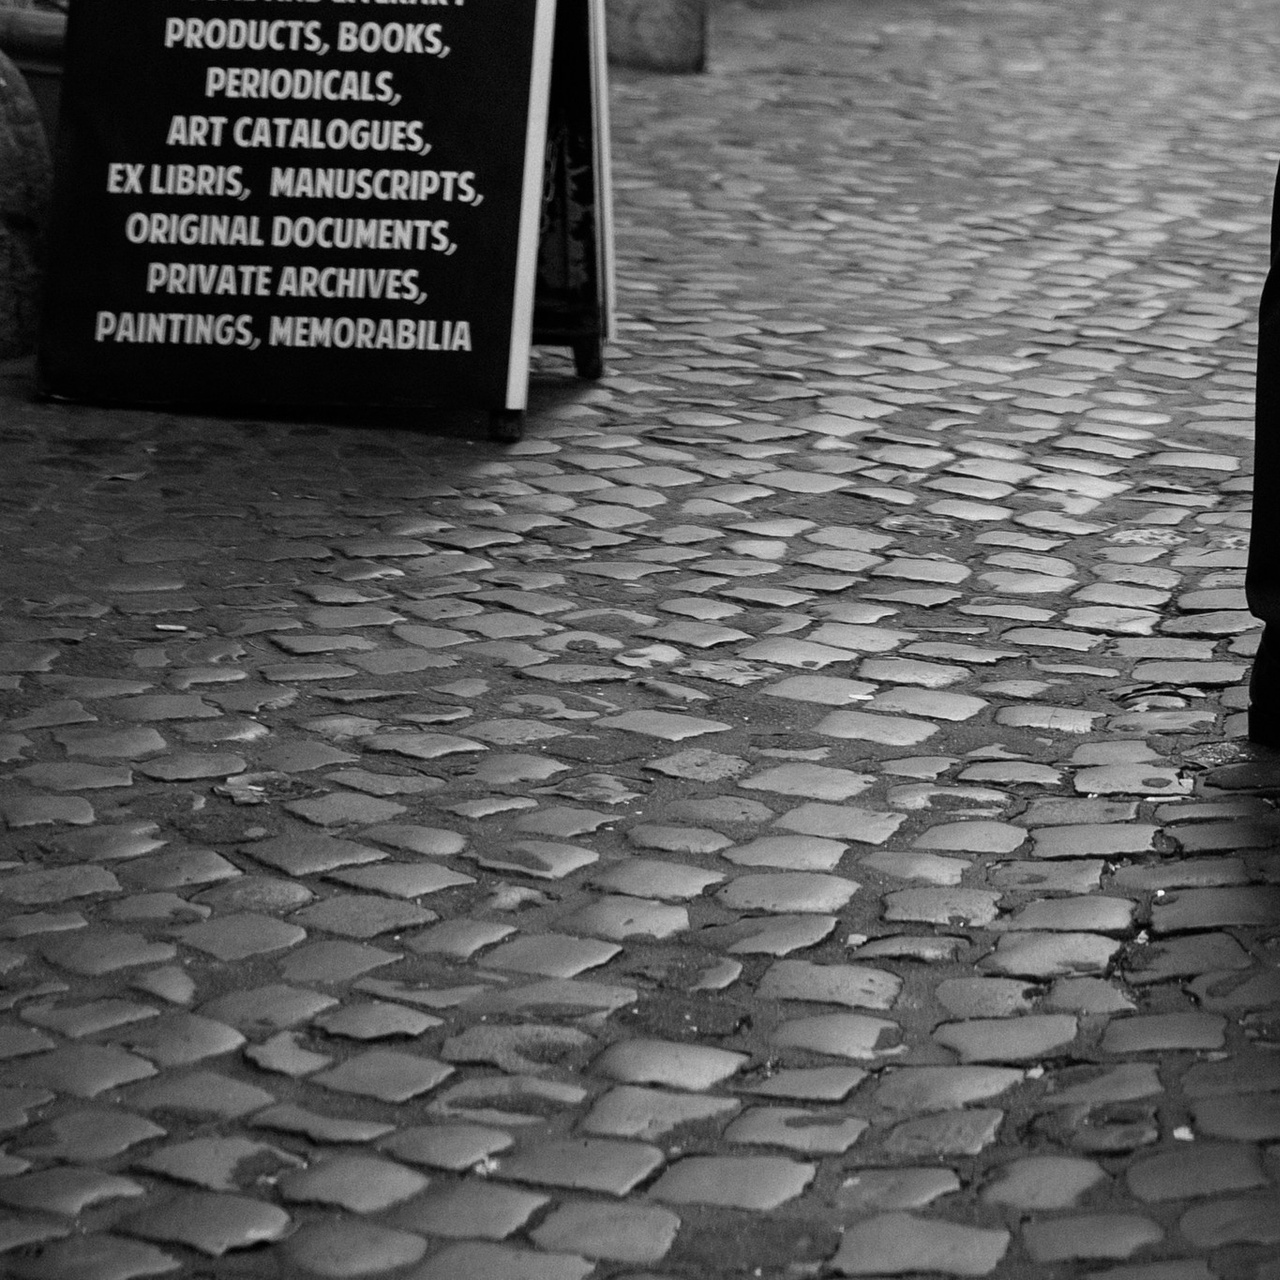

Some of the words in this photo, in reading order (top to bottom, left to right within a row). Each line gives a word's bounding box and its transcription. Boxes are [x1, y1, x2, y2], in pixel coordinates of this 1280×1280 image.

[165, 18, 329, 55] PRODUCTS,
[338, 22, 450, 58] BOOKS,
[206, 67, 401, 105] PERIODICALS,
[167, 116, 228, 146] ART
[234, 117, 431, 155] CATALOGUES,
[108, 163, 144, 193] EX
[150, 164, 250, 200] LIBRIS,
[270, 167, 483, 206] MANUSCRIPTS,
[127, 213, 264, 246] ORIGINAL
[272, 216, 457, 255] DOCUMENTS,
[148, 263, 272, 295] PRIVATE
[277, 267, 427, 304] ARCHIVES,
[96, 312, 260, 348] PAINTINGS,
[270, 316, 471, 351] MEMORABILIA
